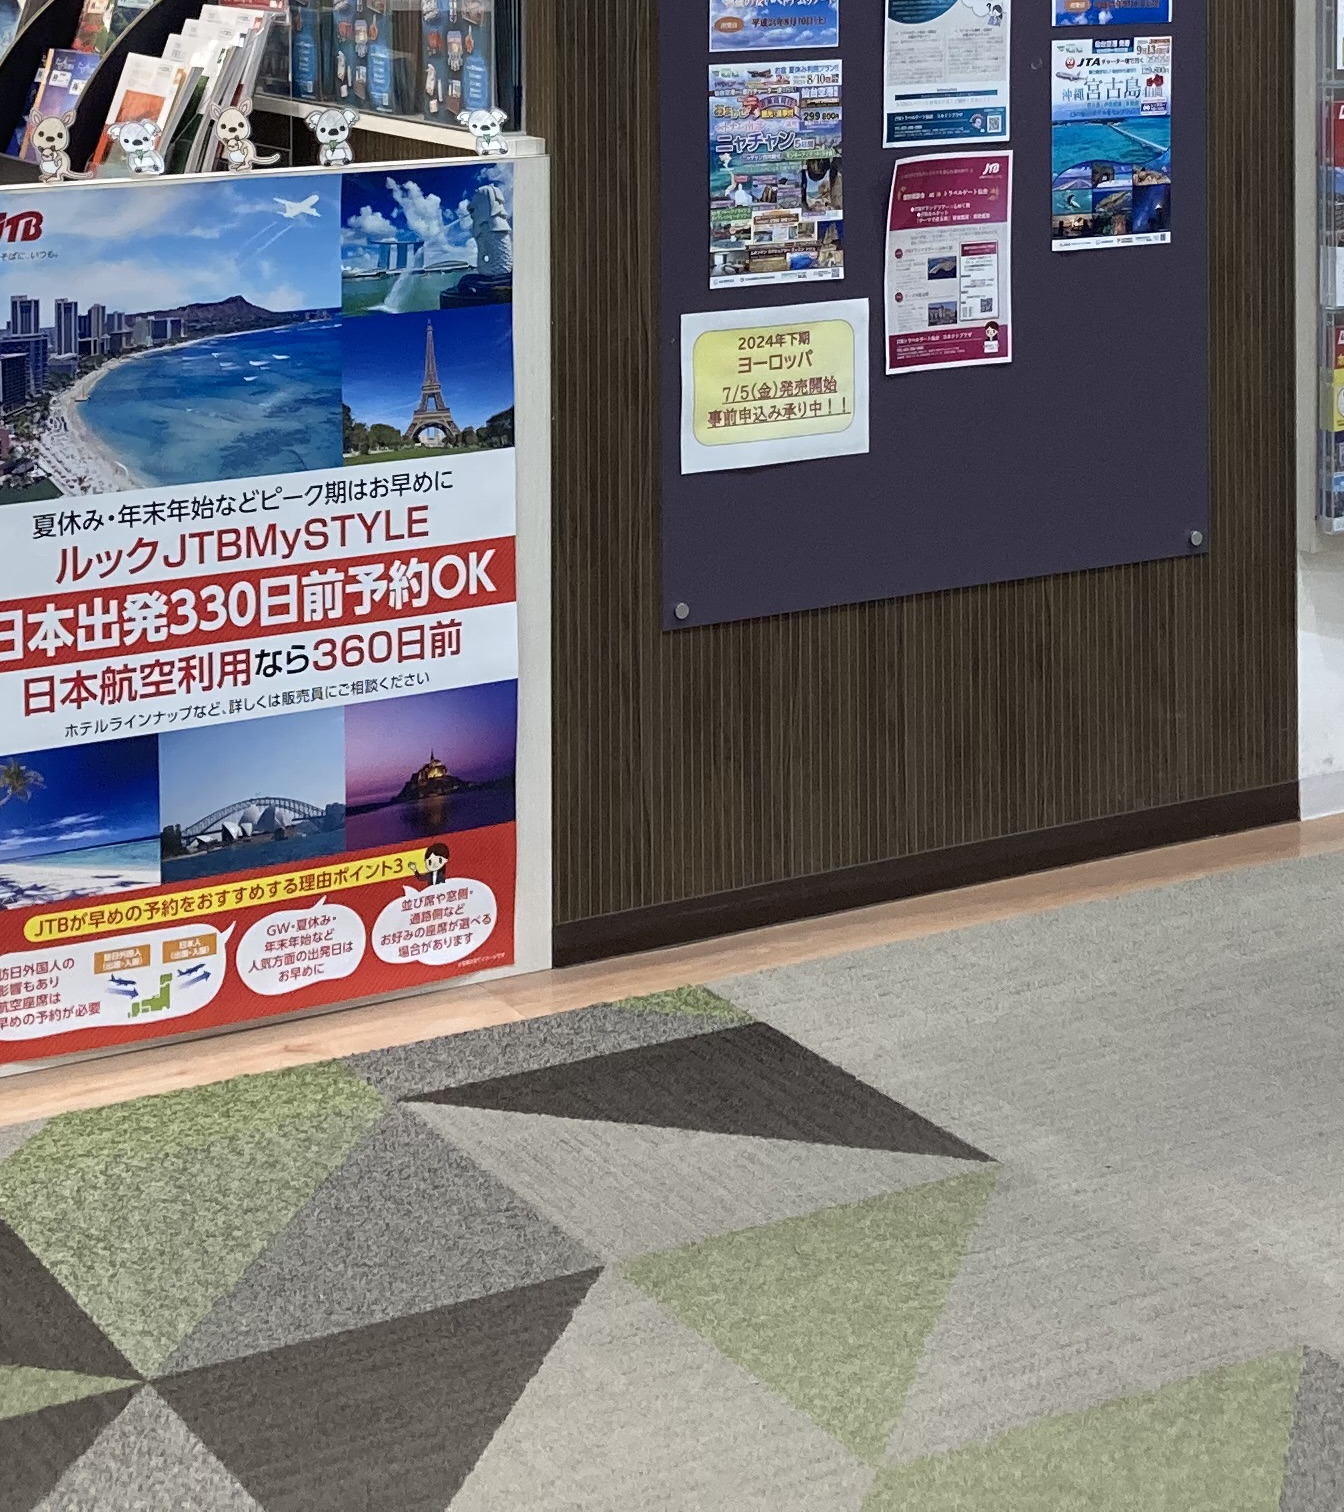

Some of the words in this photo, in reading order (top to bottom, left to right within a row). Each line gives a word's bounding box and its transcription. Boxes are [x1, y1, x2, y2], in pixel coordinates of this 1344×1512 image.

[1077, 58, 1100, 67] JTA
[738, 331, 810, 350] 2024年下期
[738, 349, 814, 374] ヨーロッパ
[33, 470, 455, 540] 夏休み・年末年始などピーク期はお早めに
[55, 504, 430, 585] ルックJTBMySTYLE
[23, 619, 463, 717] 日本航空利用なら360日前
[64, 672, 430, 739] ホテルラインナップなど、詳しくは販売員にご相談ください
[34, 858, 404, 938] JTBが早めの予約をおすすめする理由ポイント3
[409, 904, 466, 925] 通路側など
[264, 927, 335, 953] 年末年始など
[380, 914, 492, 946] お好みの座席が選べる
[398, 931, 474, 958] 場合があります
[248, 941, 354, 973] 人気方面の出発日は
[278, 963, 325, 983] お早めに
